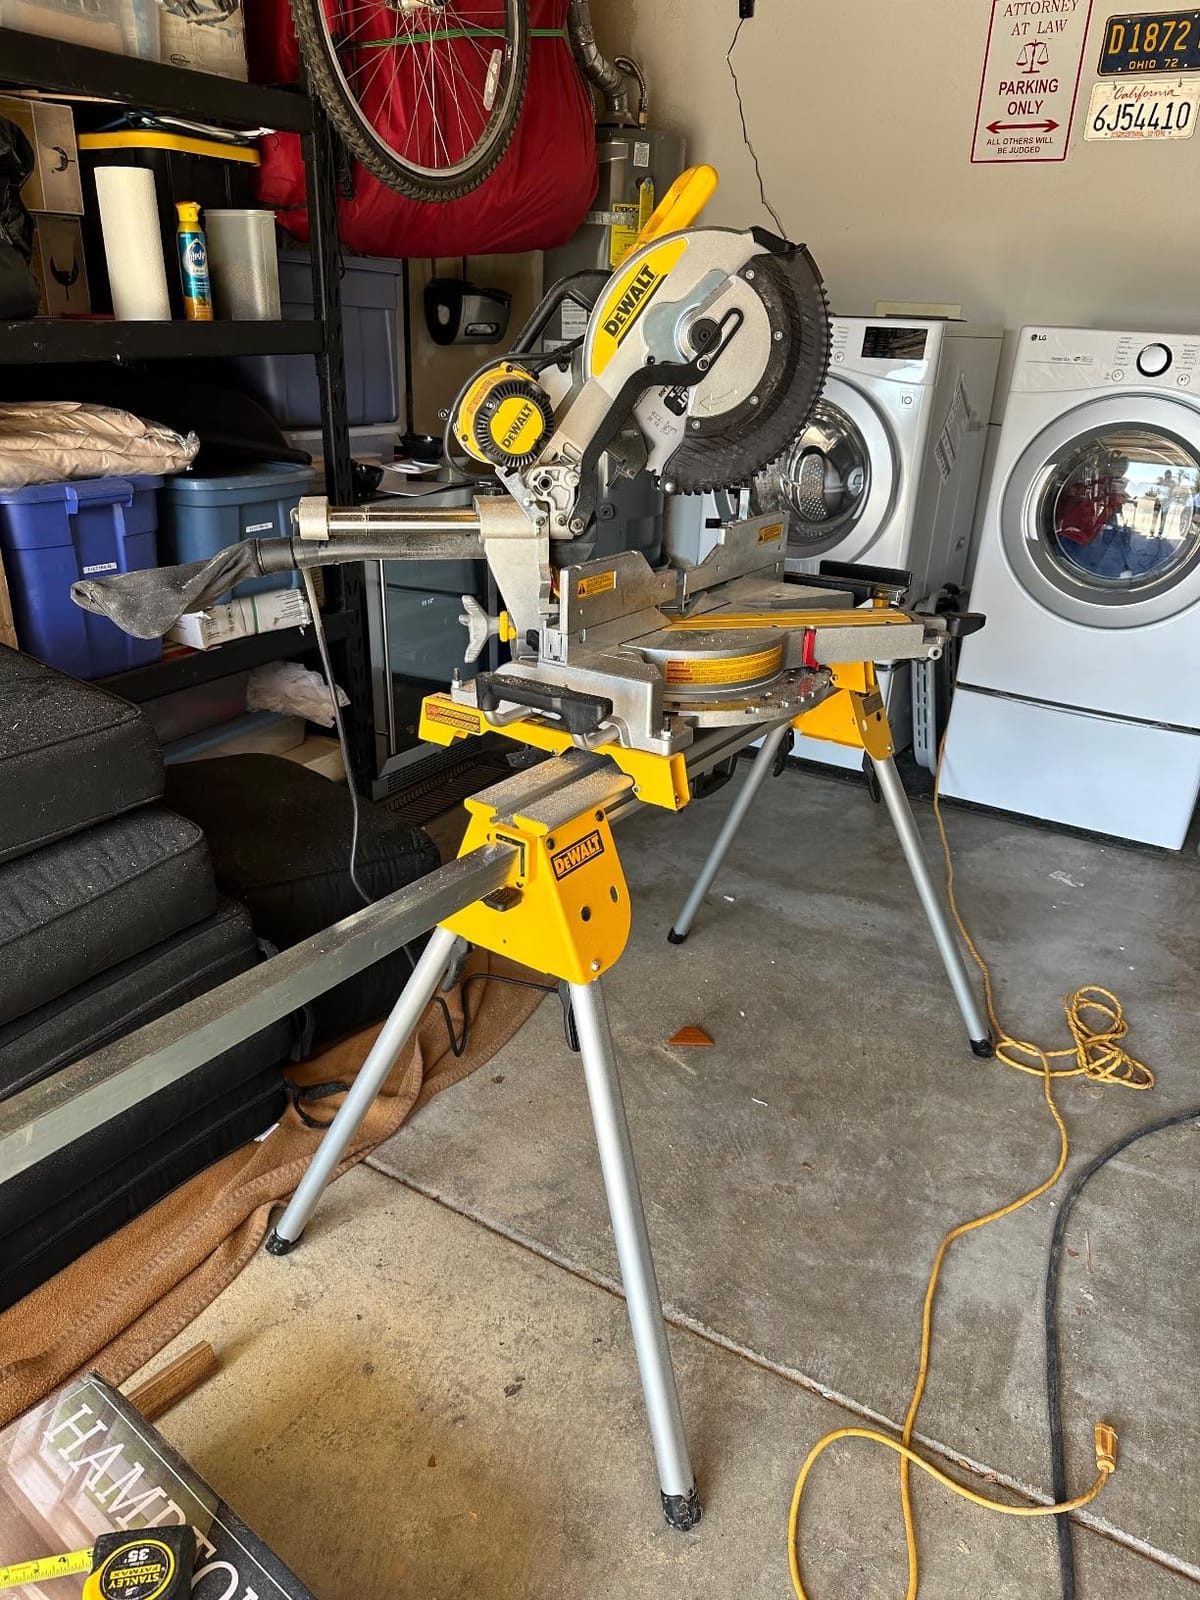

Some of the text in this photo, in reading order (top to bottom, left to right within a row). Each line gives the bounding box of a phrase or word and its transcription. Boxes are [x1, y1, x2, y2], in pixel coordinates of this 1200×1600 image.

[1003, 0, 1079, 17] ATTORNEY
[1011, 19, 1068, 36] AT LAW
[1108, 20, 1192, 54] D1872
[1128, 58, 1179, 70] OHIO 72
[998, 78, 1059, 96] PARKING
[1113, 85, 1181, 103] California
[1007, 99, 1044, 116] ONLY
[1093, 101, 1191, 132] 6J54410
[986, 136, 1054, 146] ALL OTHERS WILL
[1008, 146, 1041, 154] JUDGED
[603, 264, 656, 338] DEWALT
[502, 405, 533, 448] DEWALT
[553, 834, 601, 876] DEWALT
[108, 1572, 160, 1590] STANLEY
